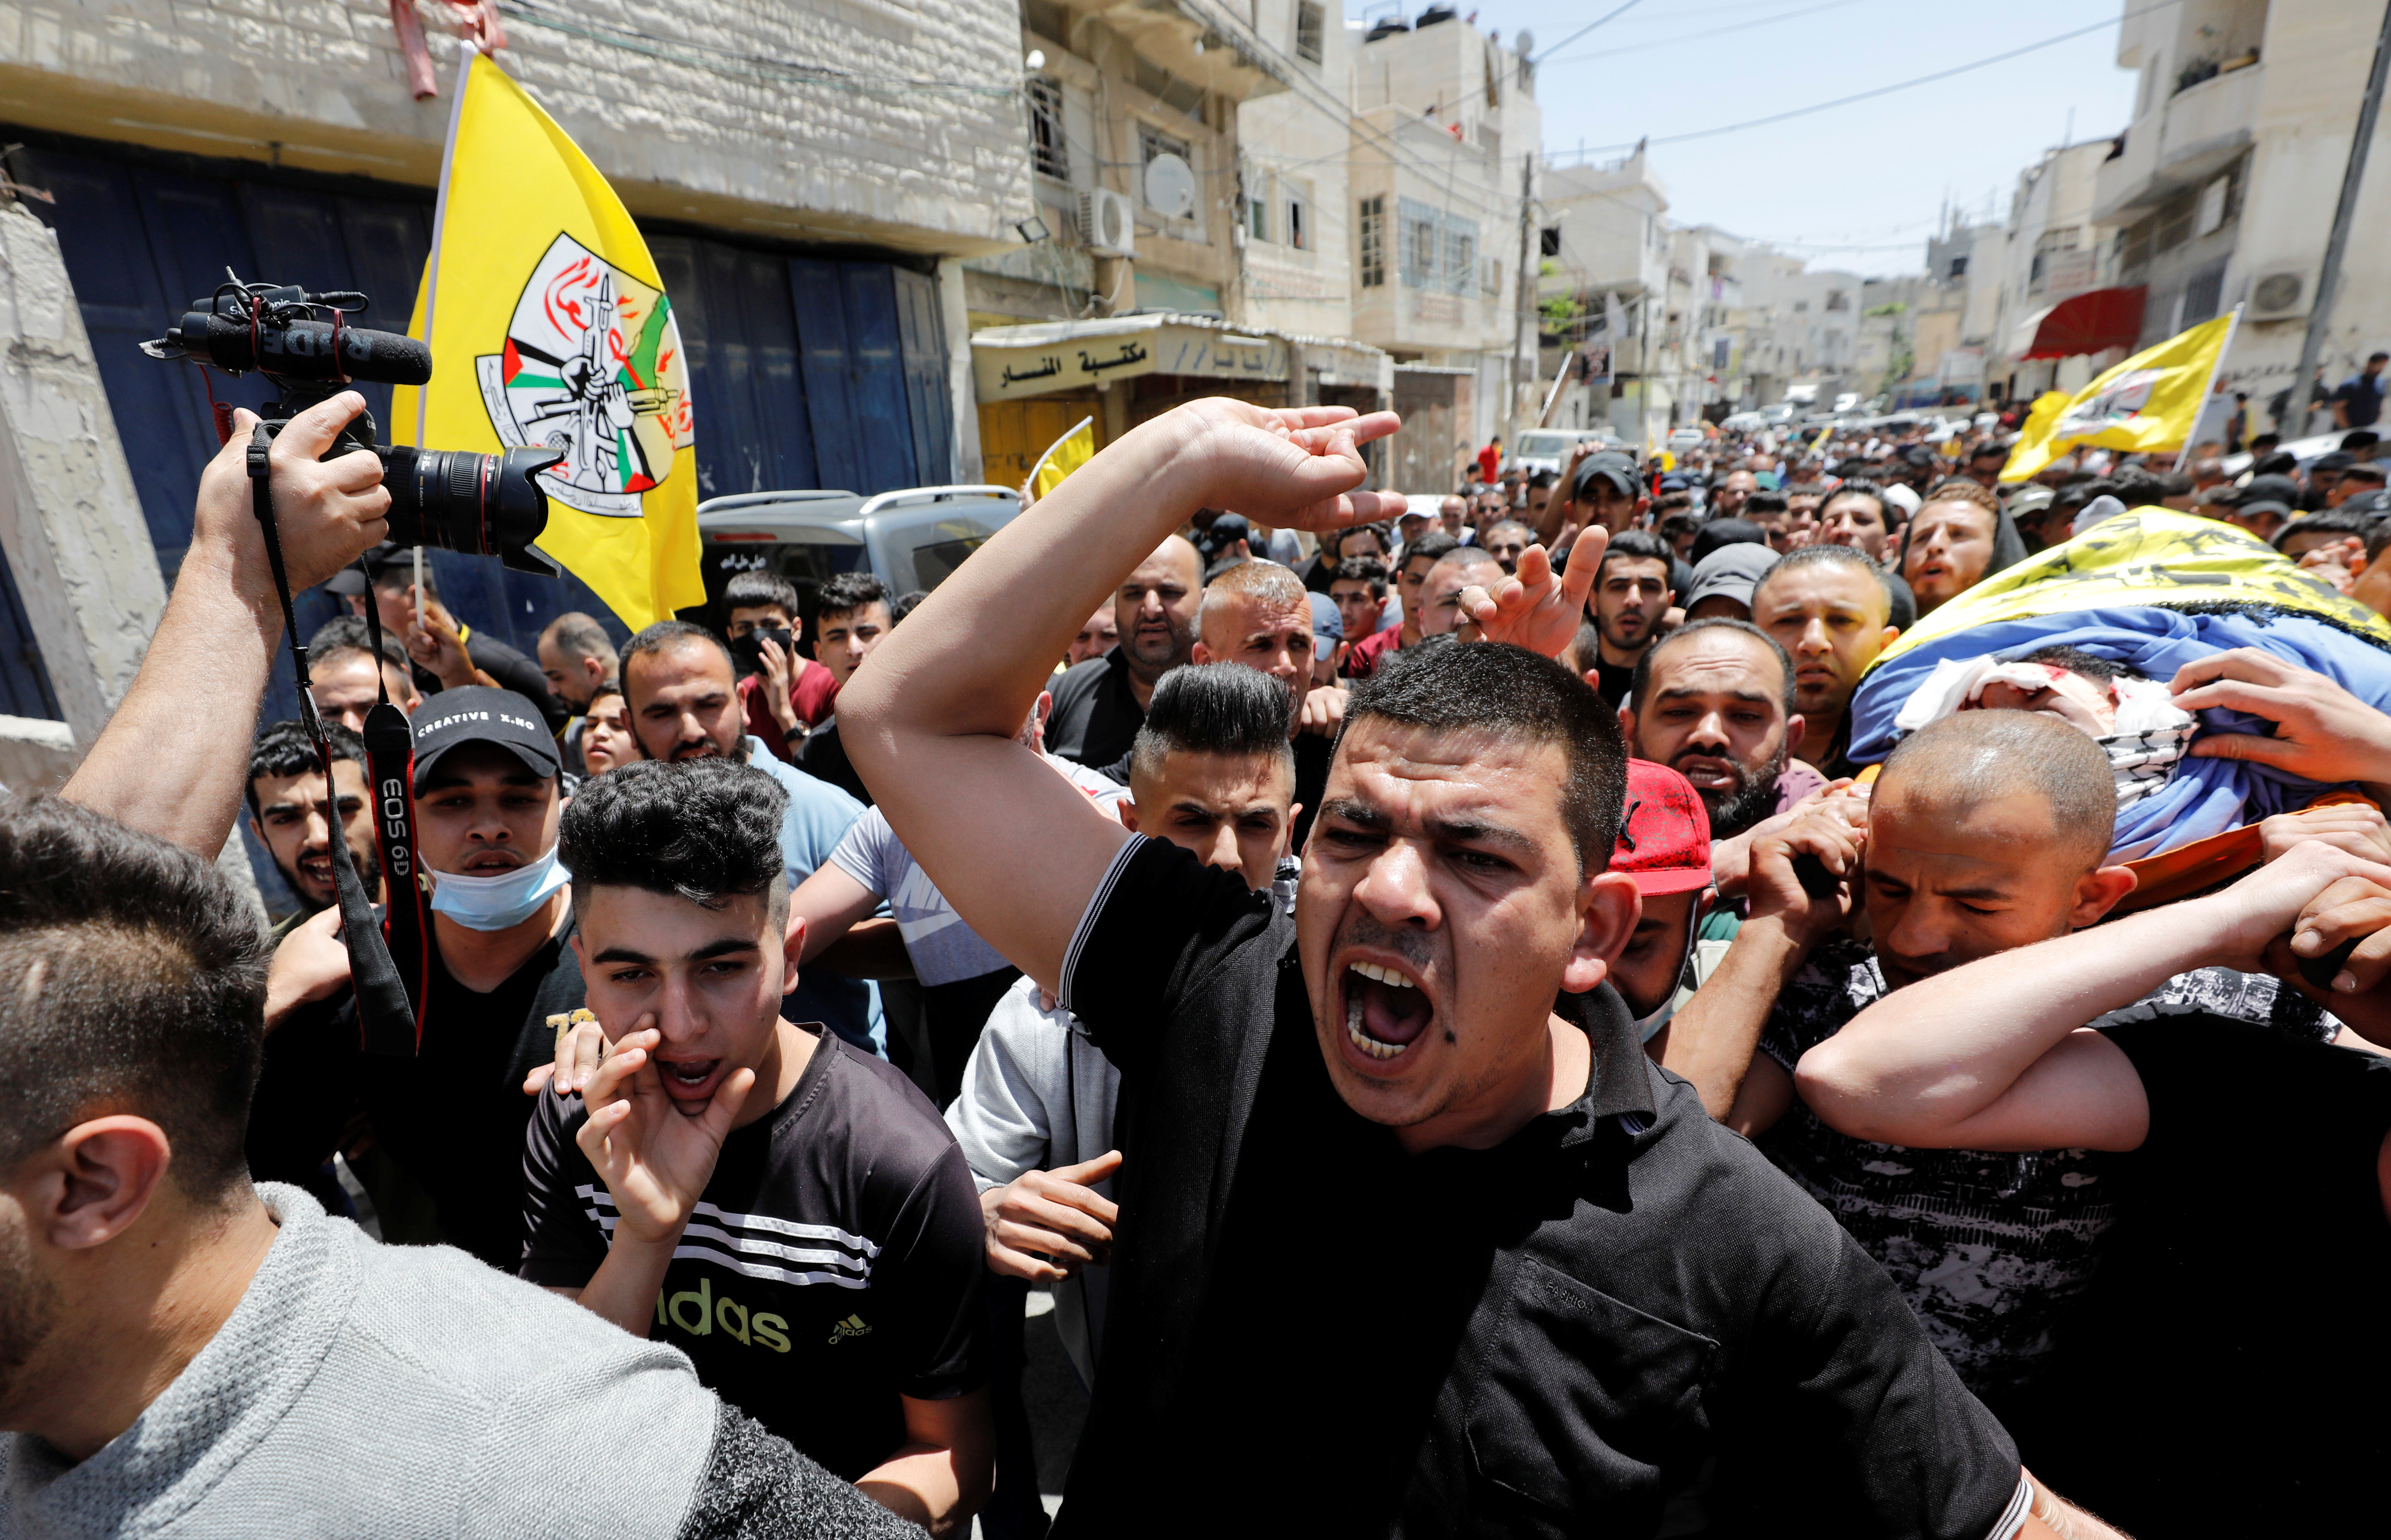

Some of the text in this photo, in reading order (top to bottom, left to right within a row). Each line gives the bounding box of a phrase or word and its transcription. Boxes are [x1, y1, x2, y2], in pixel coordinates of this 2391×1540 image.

[417, 711, 536, 738] CREATIVE X.NO
[383, 778, 410, 876] EOS 6D
[1546, 1281, 1595, 1313] FASHION
[828, 1325, 872, 1344] adidas
